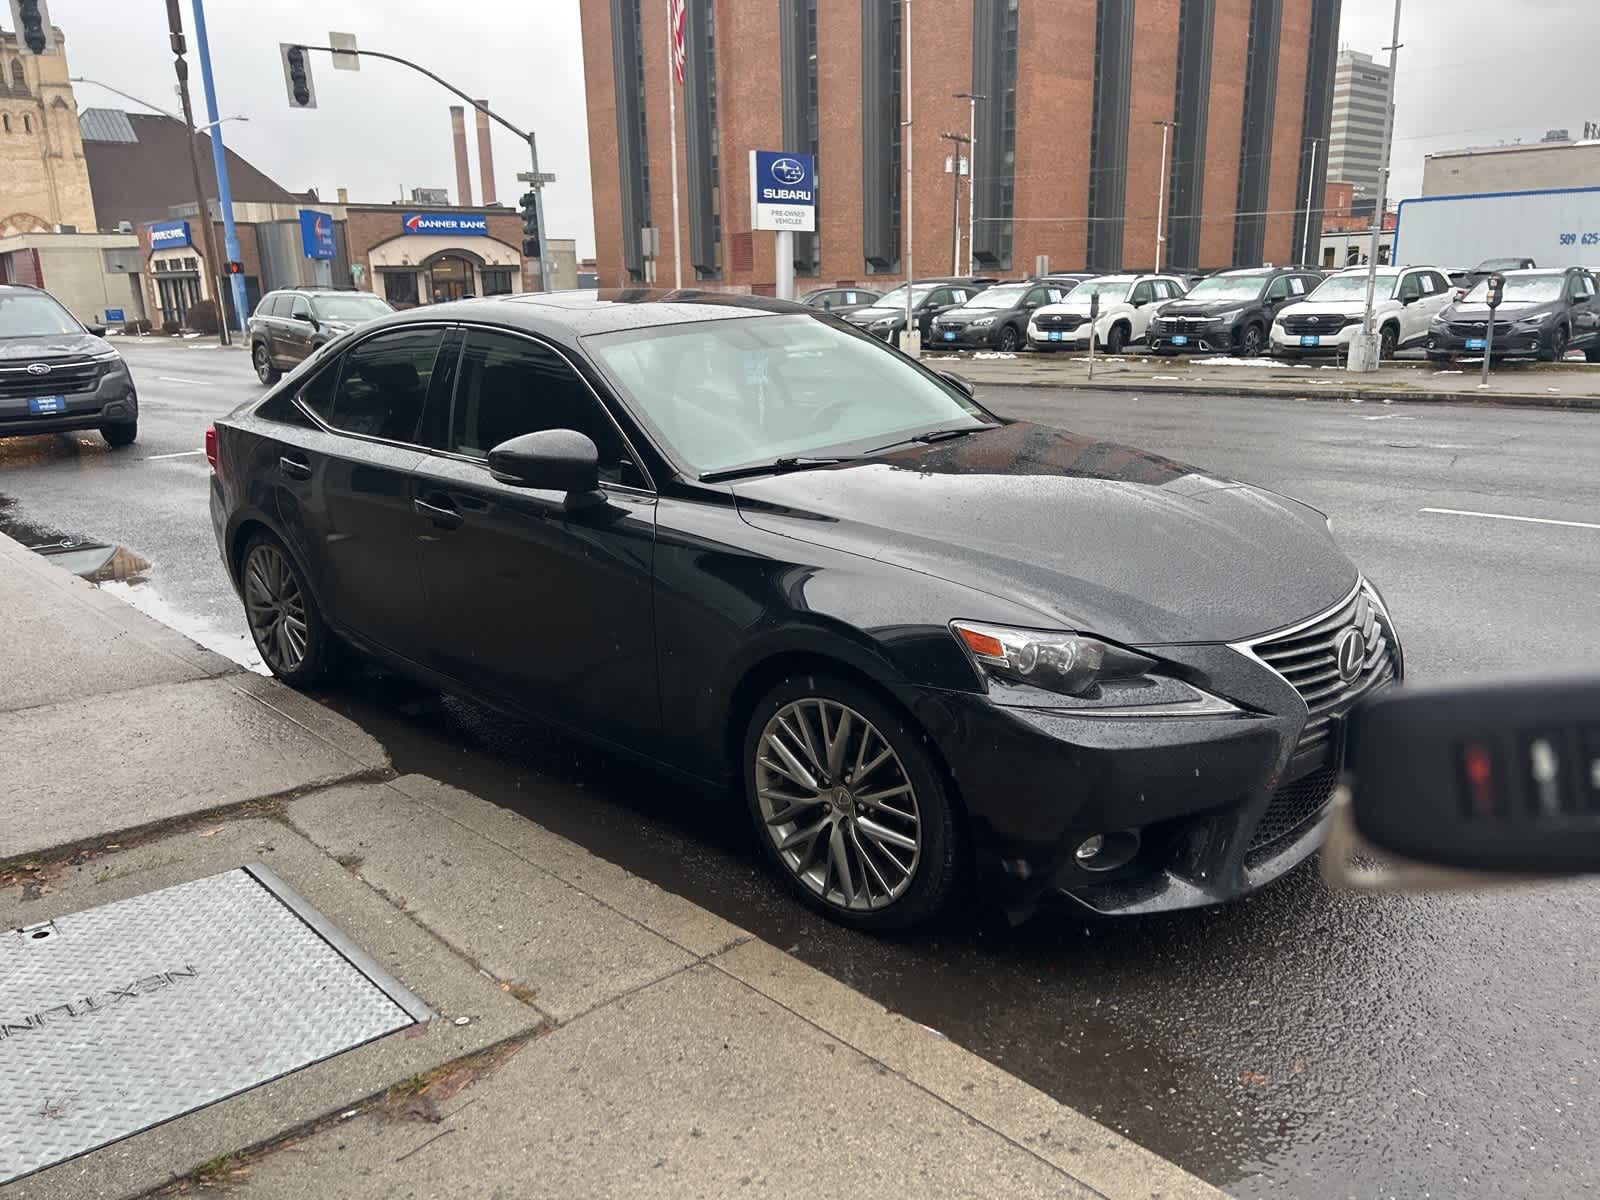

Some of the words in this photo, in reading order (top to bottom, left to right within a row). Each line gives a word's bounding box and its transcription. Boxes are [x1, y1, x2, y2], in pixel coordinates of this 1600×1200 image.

[763, 188, 811, 200] SUBARU
[418, 220, 458, 229] BANNER
[460, 220, 487, 230] BANK
[1559, 233, 1577, 246] 509
[0, 964, 199, 1041] NEXTLIN
